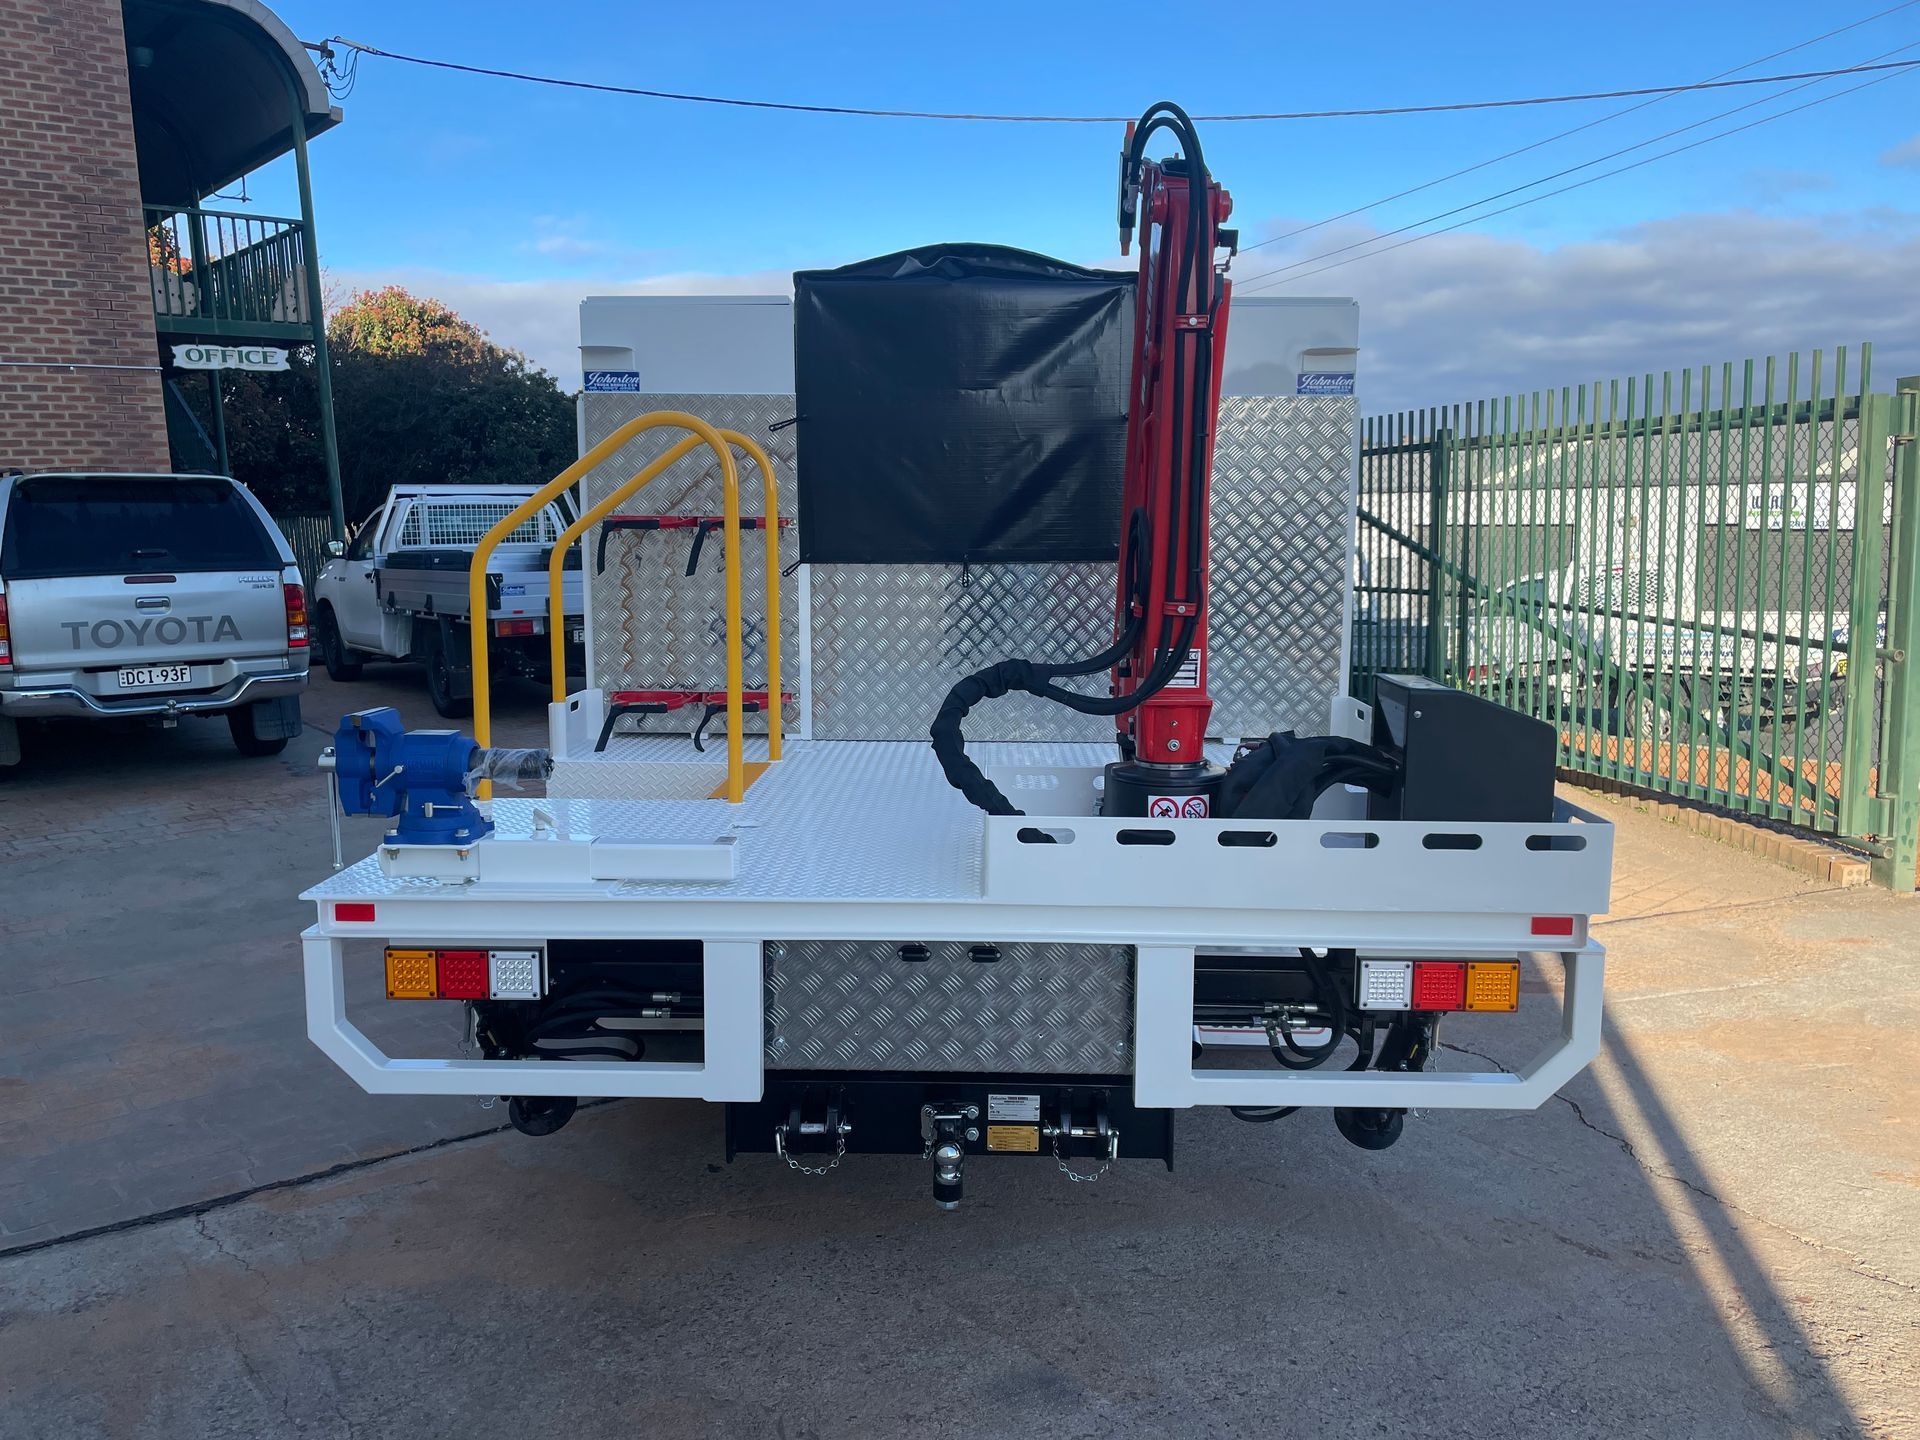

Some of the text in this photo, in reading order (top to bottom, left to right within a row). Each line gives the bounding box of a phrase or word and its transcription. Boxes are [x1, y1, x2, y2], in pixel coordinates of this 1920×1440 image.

[185, 348, 278, 365] OFFICE
[584, 371, 640, 387] Johnston
[1297, 374, 1354, 389] Johnston
[61, 615, 243, 649] TOYOTA
